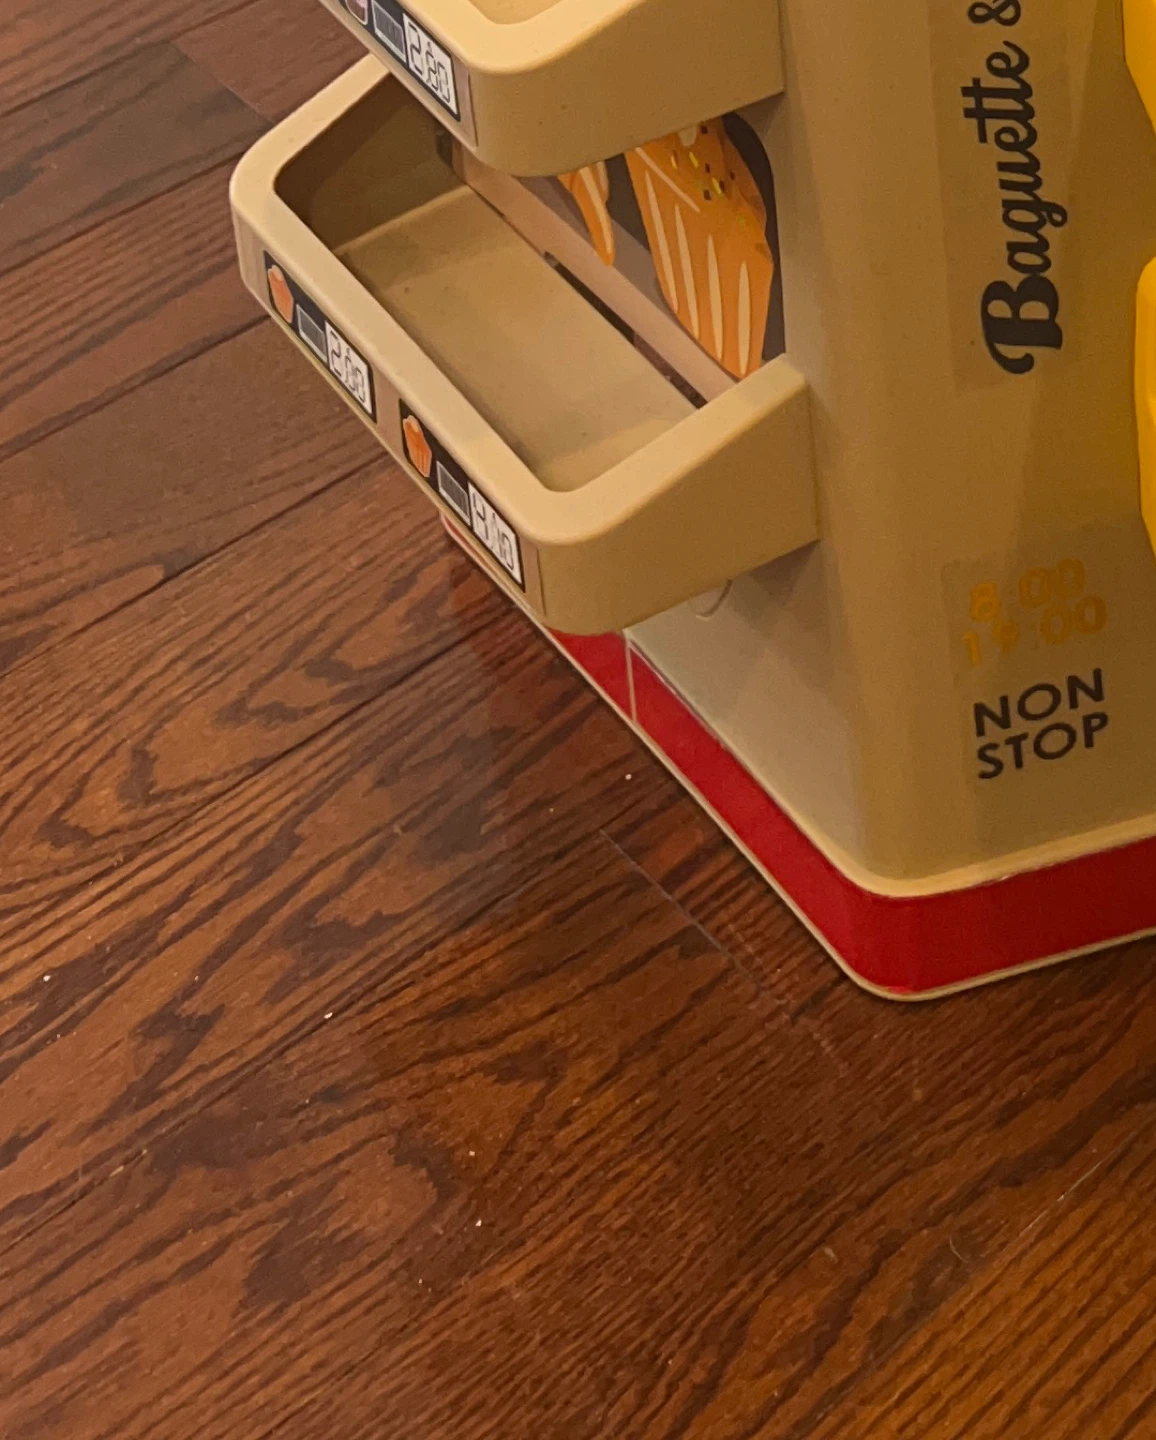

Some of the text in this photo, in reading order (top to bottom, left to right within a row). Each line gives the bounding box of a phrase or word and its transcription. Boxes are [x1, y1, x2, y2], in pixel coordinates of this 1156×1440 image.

[963, 40, 1069, 375] Baguette
[973, 668, 1105, 737] NON
[977, 711, 1109, 779] STOP
